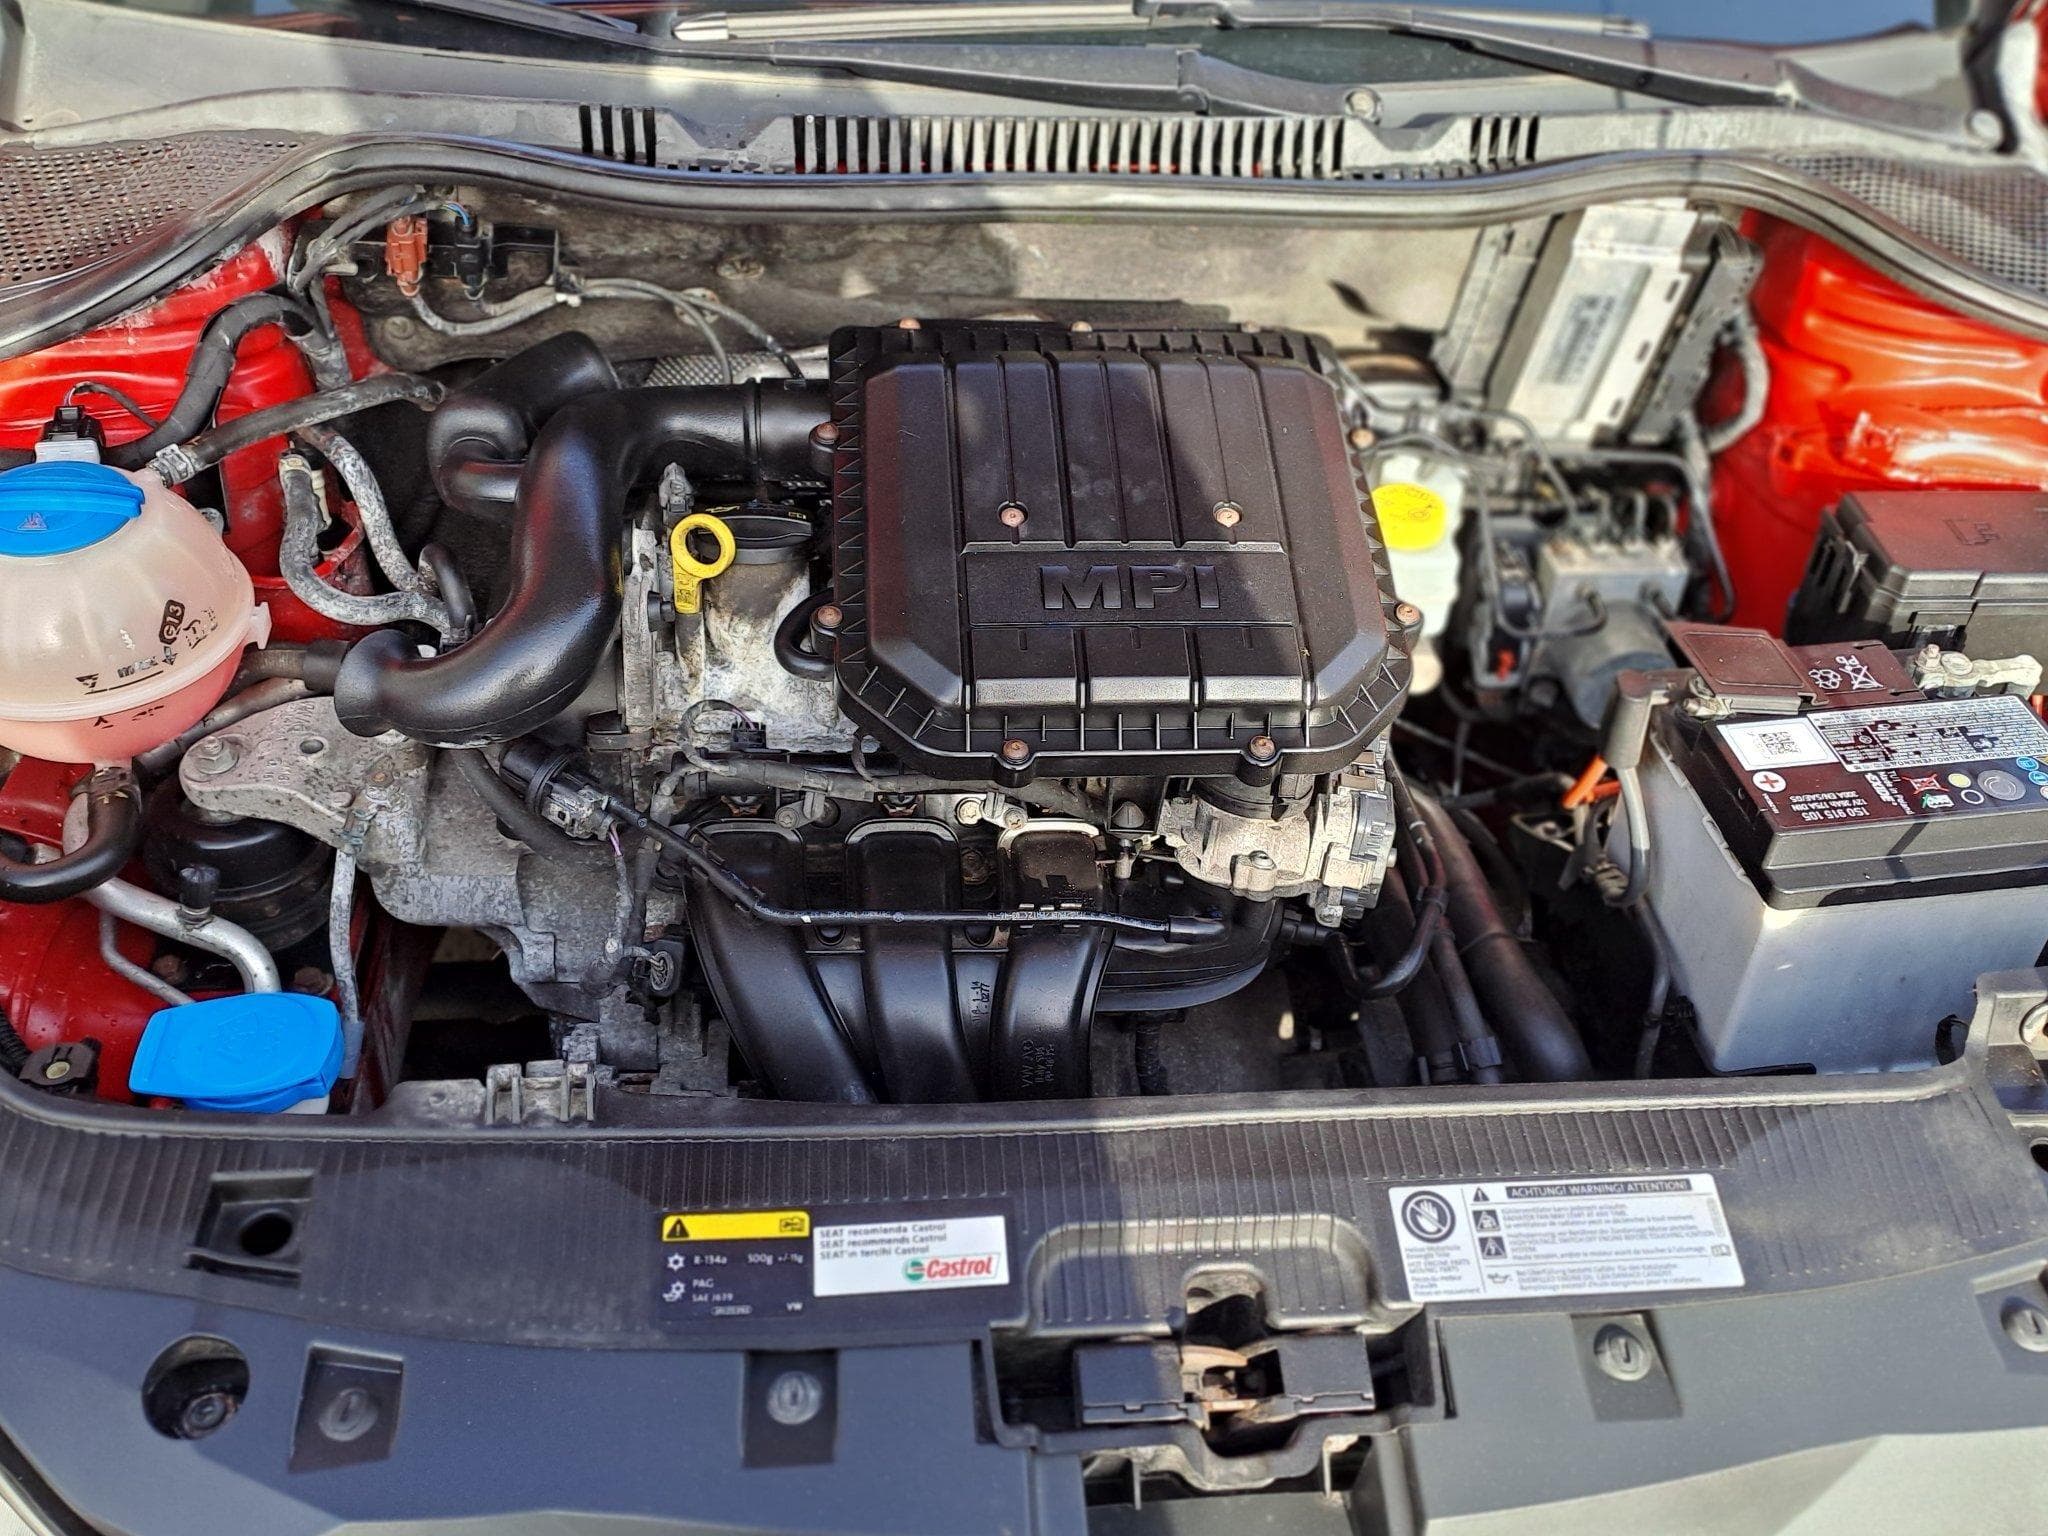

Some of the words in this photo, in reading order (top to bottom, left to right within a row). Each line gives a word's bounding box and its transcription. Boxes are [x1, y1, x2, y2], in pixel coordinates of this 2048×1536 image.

[1039, 565, 1221, 610] MPI
[1836, 655, 1860, 665] Pb
[1894, 794, 1916, 815] Poland
[1801, 811, 1824, 822] 105
[1824, 809, 1847, 820] 915
[1511, 1185, 1567, 1198] ACHTUNG!
[1568, 1182, 1626, 1195] WARNING!
[1627, 1179, 1689, 1193] ATTENTION!
[820, 1229, 844, 1239] SEAT
[911, 1223, 947, 1233] Castrol
[820, 1240, 844, 1249] SEAT
[847, 1237, 910, 1248] recommends
[912, 1233, 947, 1243] Castrol
[894, 1245, 930, 1255] Castrol
[926, 1256, 994, 1278] Castrol
[692, 1278, 714, 1288] PAG
[786, 1301, 803, 1311] VW
